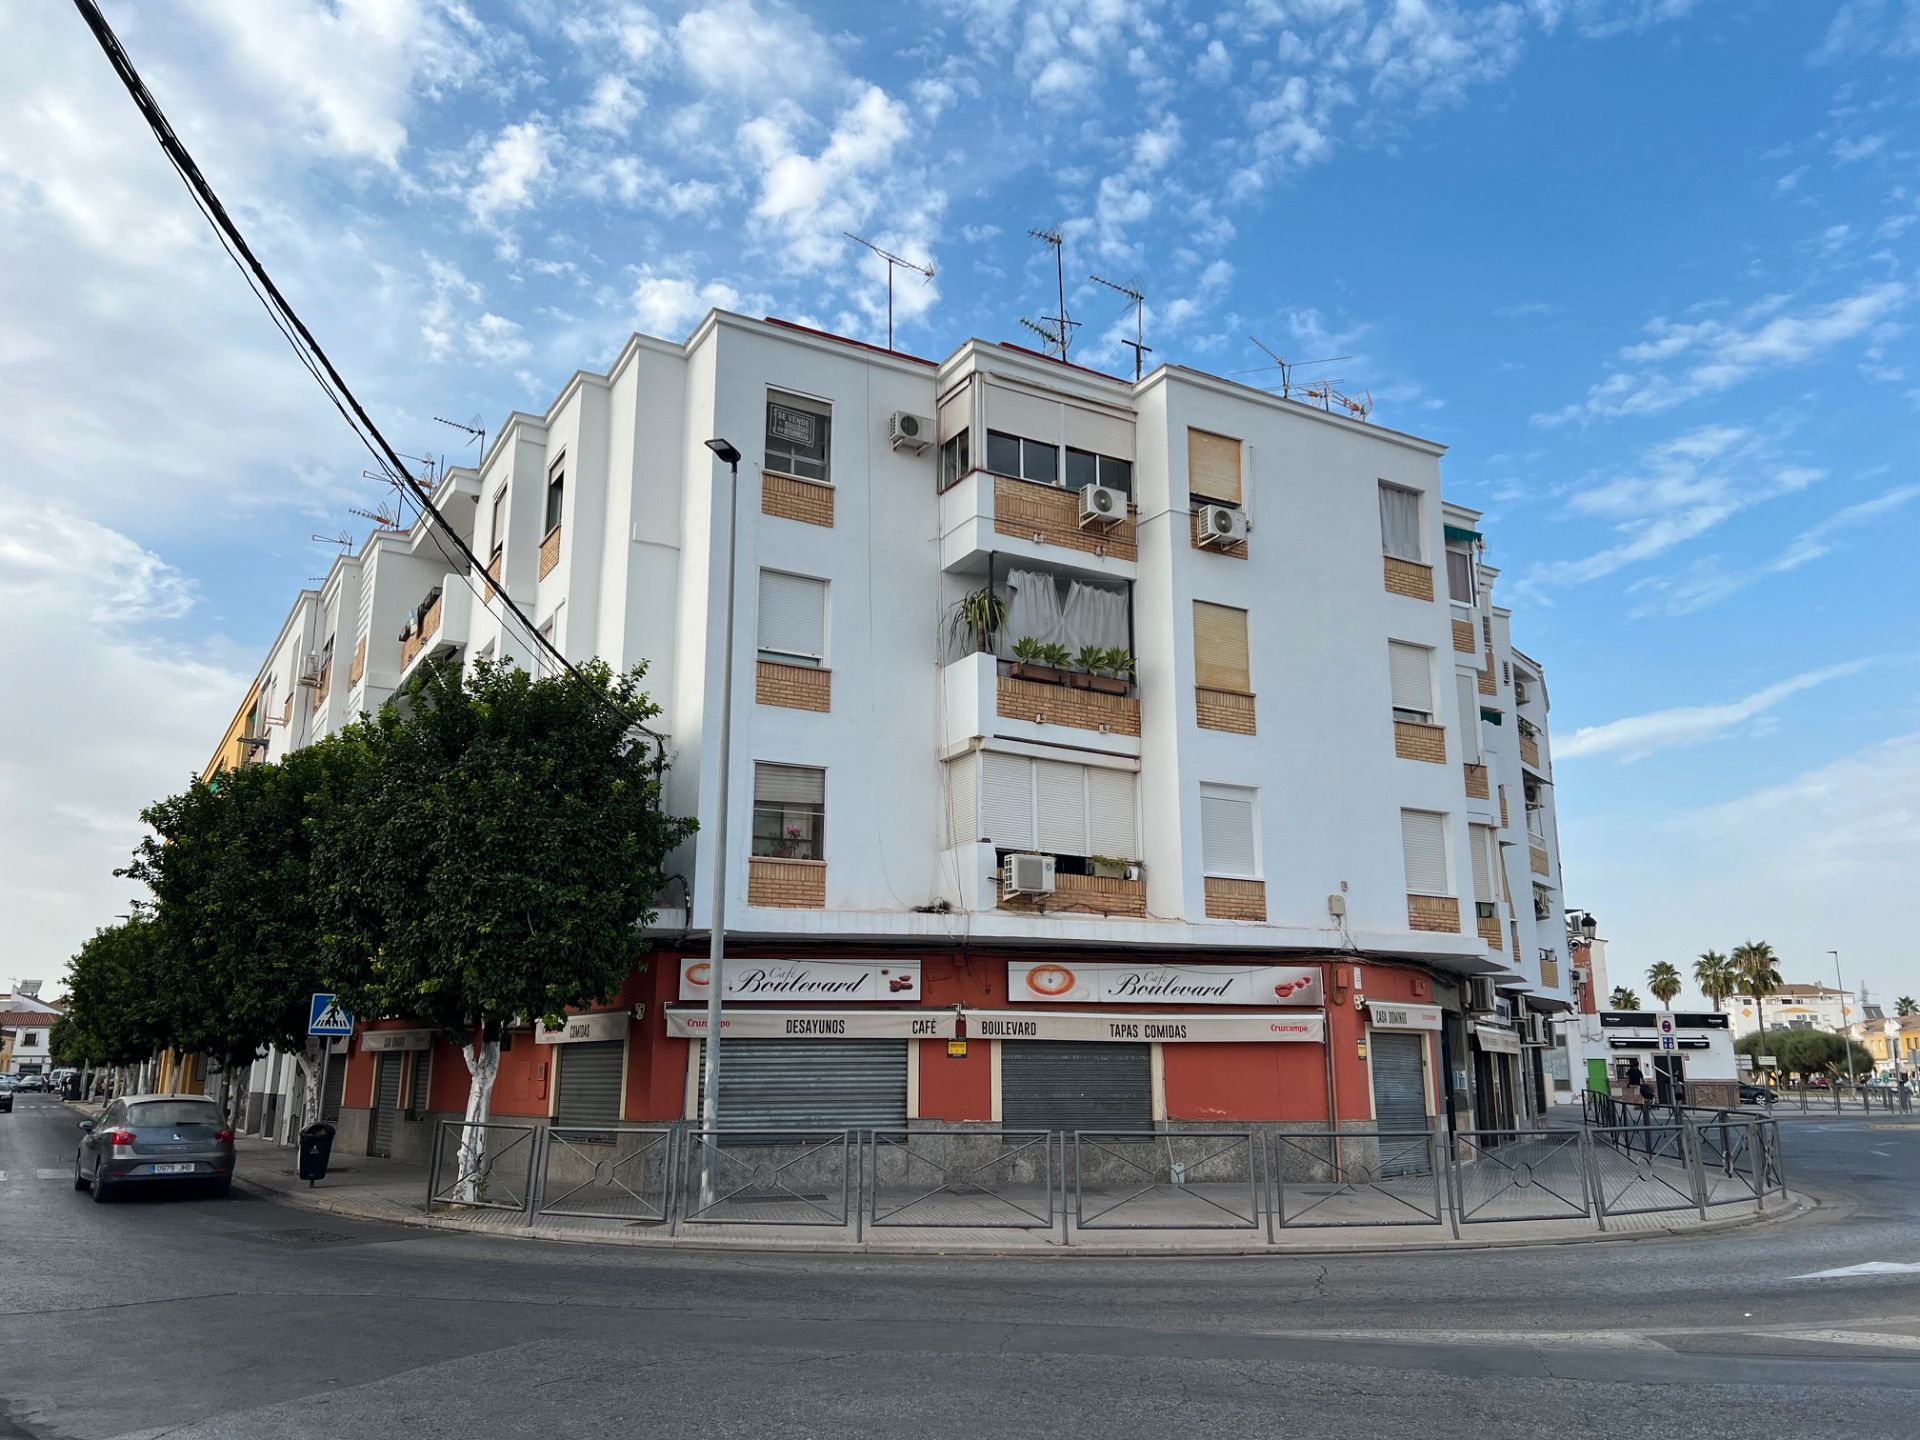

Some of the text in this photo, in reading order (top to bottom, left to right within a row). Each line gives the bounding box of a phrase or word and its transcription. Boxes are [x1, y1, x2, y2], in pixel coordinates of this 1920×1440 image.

[777, 411, 810, 426] SE VENDE
[729, 969, 869, 993] Boulevard
[1108, 973, 1234, 996] Boulevard
[786, 1019, 937, 1034] DESAYUNOS CAFÉ
[981, 1021, 1187, 1038] BOULEVARD TAPAS COMIDAS
[1271, 1024, 1308, 1033] Cruzcampo
